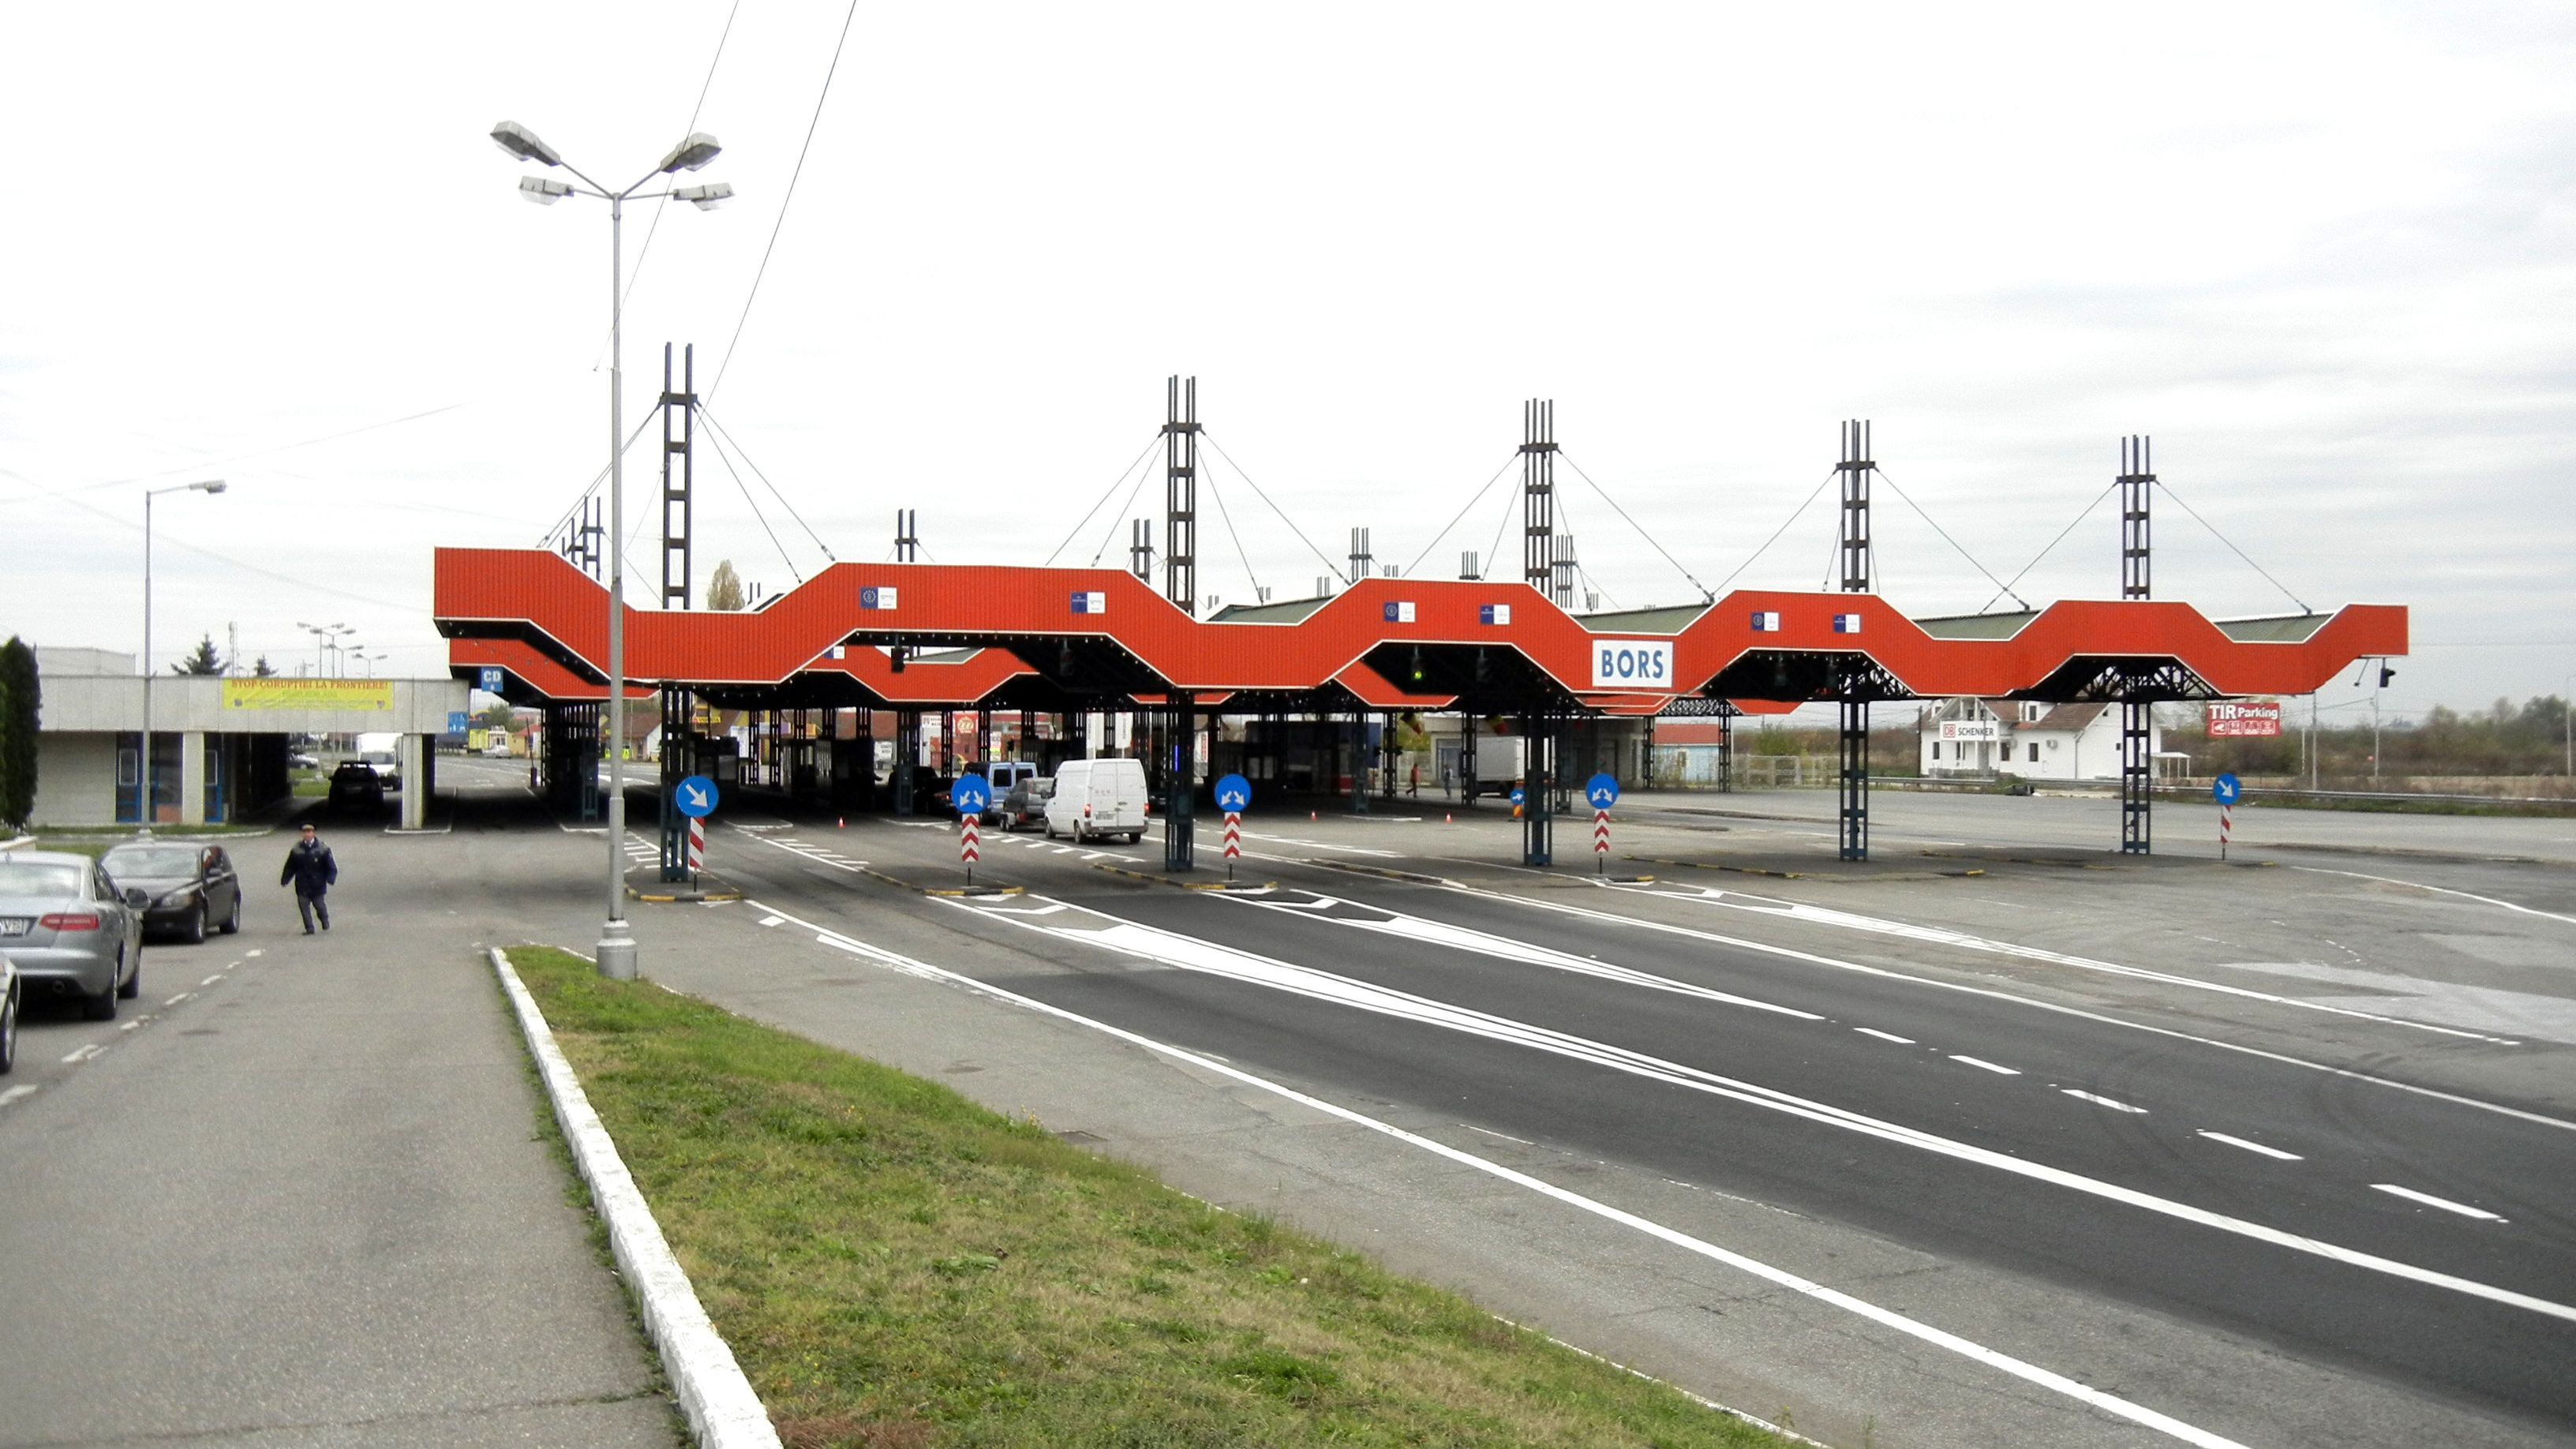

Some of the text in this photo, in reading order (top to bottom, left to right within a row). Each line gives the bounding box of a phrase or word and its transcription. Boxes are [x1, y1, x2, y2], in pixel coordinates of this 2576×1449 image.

[1601, 649, 1664, 679] BORS
[483, 670, 502, 683] CD
[231, 680, 258, 689] STOP
[316, 680, 328, 689] LA
[2208, 703, 2278, 720] TIR Parking
[1944, 725, 1994, 736] DB SCHENKER
